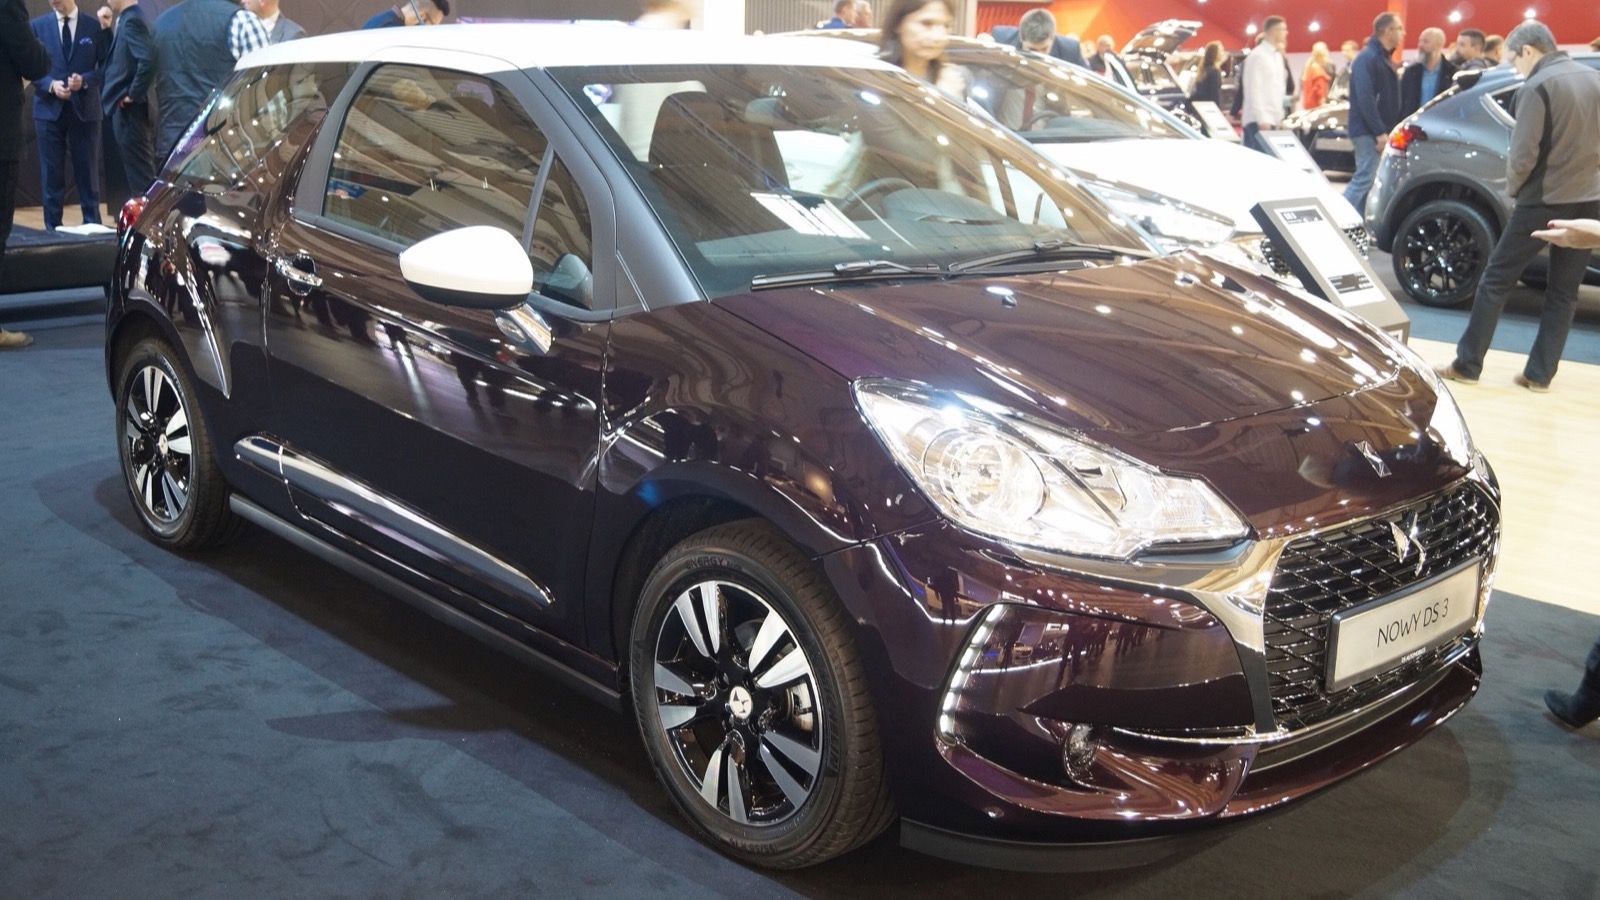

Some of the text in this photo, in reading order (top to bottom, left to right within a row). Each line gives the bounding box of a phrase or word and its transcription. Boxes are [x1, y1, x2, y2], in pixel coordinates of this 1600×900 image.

[1377, 598, 1449, 647] NOWY DS 3
